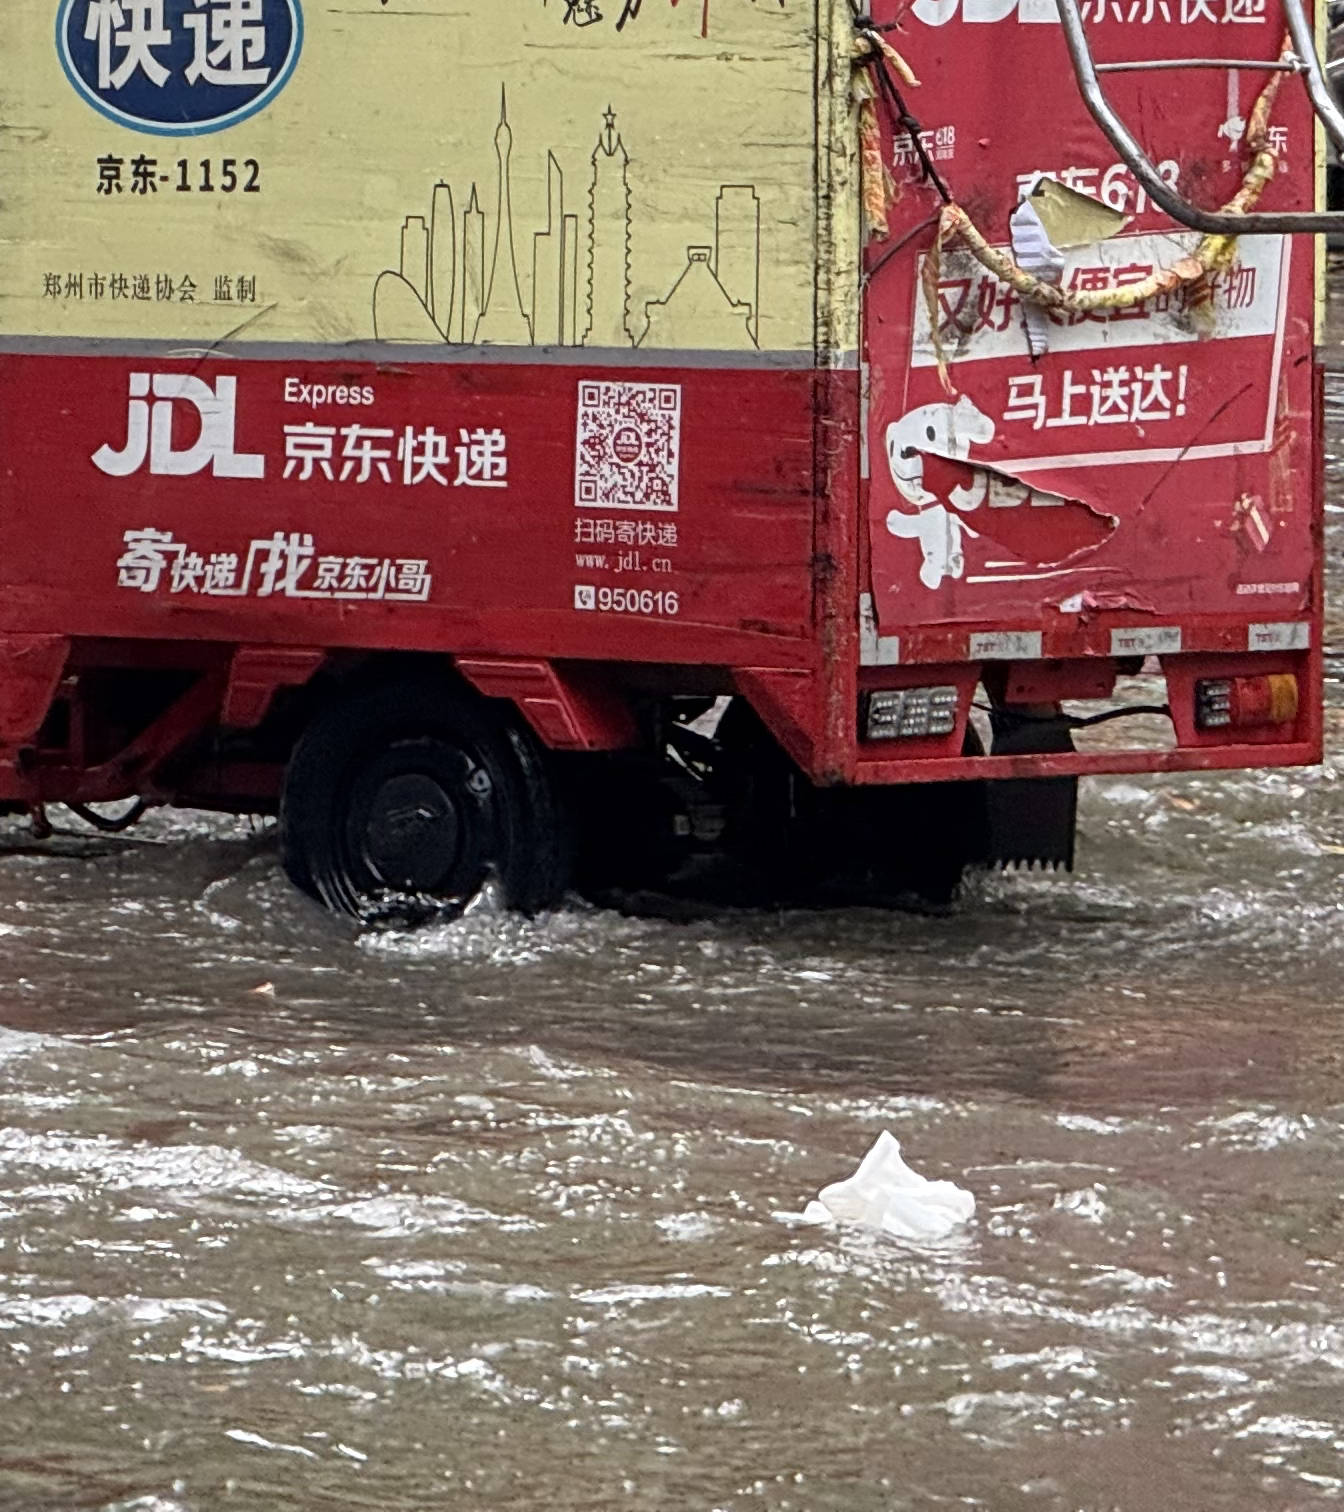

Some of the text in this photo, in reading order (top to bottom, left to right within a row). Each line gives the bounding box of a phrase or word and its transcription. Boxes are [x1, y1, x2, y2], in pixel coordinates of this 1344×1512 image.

[96, 154, 261, 195] 京东-1152
[42, 272, 257, 304] 郑州市快递协会 监制
[284, 378, 374, 409] Express
[1002, 365, 1188, 429] 马上送达!
[91, 372, 265, 478] JDL
[282, 422, 508, 488] 京东快递
[574, 518, 678, 547] 扫码寄快递
[598, 588, 679, 614] 950616
